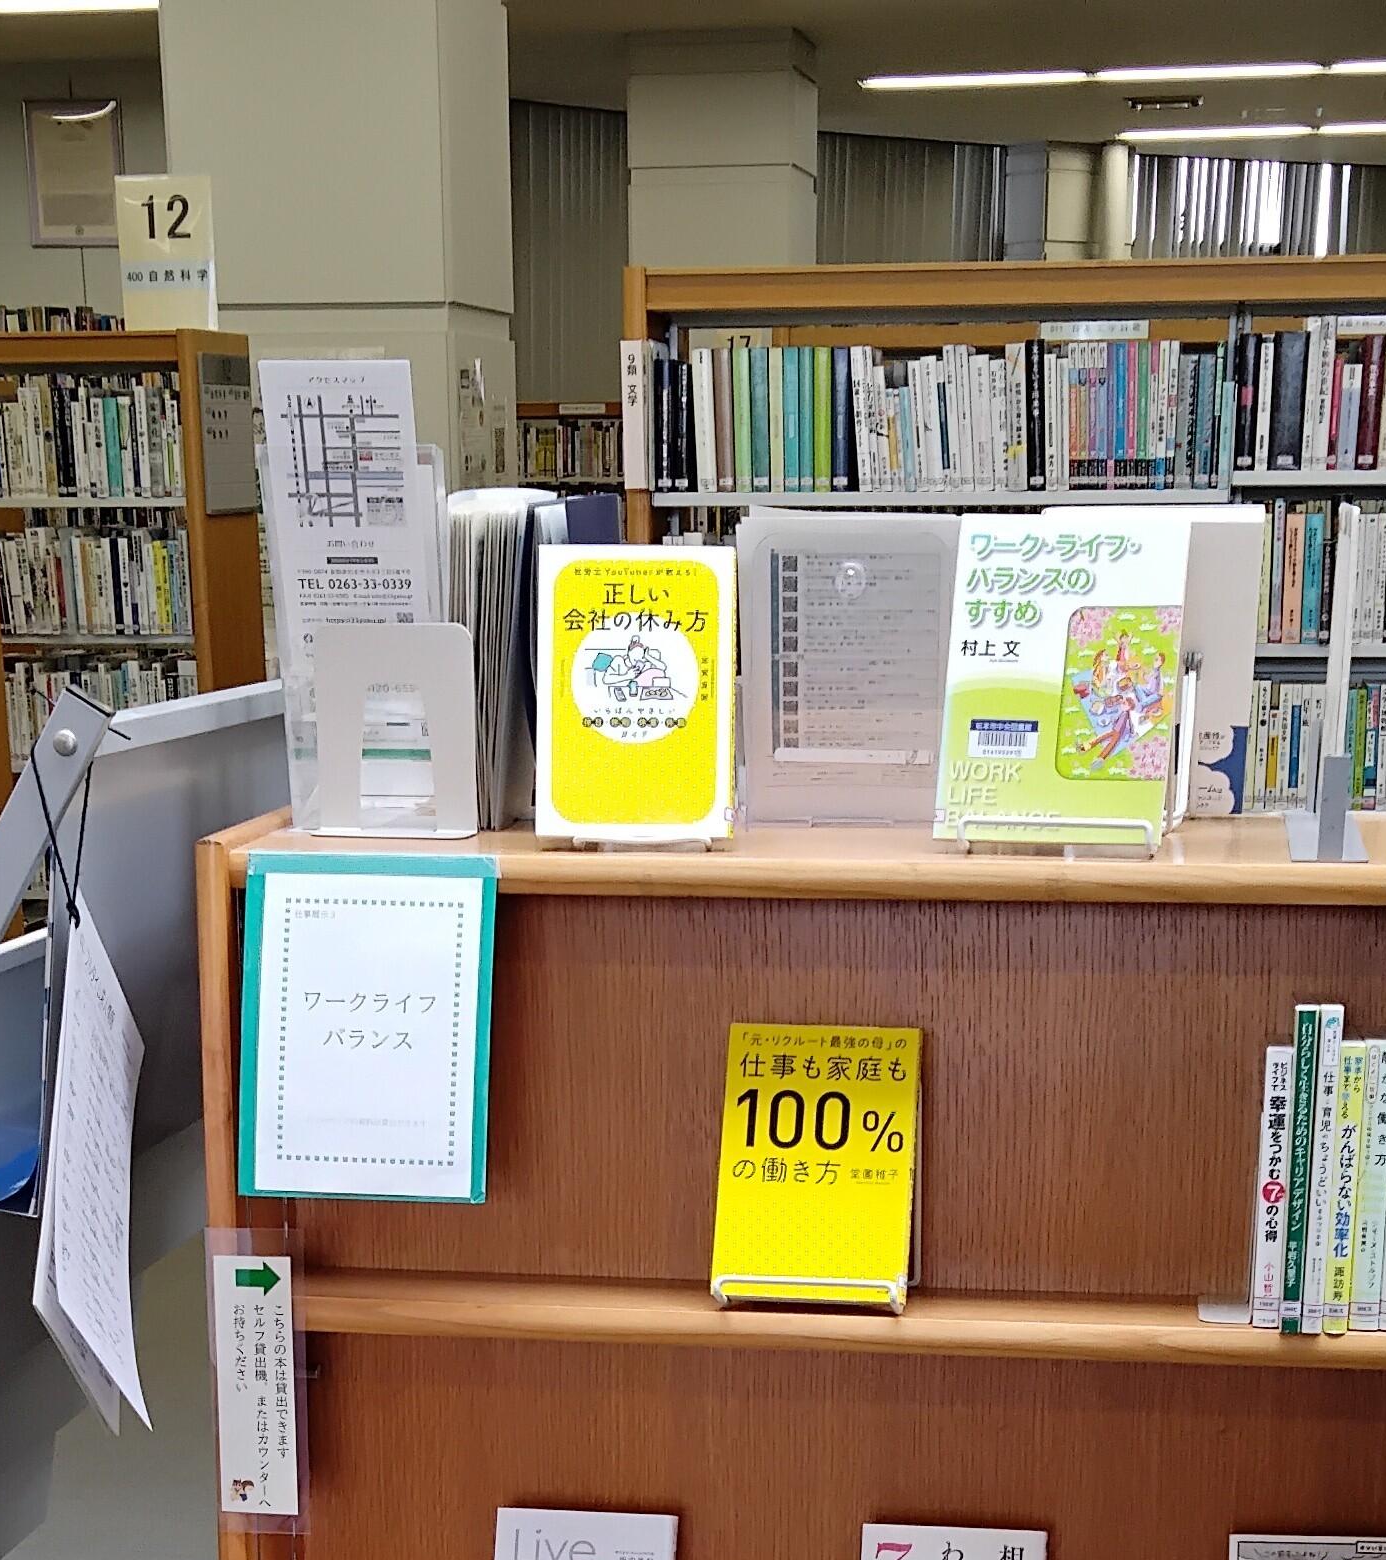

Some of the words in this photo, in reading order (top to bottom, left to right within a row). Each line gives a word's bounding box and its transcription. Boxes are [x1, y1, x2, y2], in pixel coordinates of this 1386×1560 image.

[140, 194, 192, 241] 12
[126, 269, 144, 284] 400
[147, 267, 209, 284] 自然科学
[625, 353, 638, 377] 9類
[625, 383, 638, 407] 文学
[326, 540, 375, 548] お問い合わせ
[970, 533, 1140, 560] ワーク・ライフ・
[297, 578, 325, 590] TEL
[328, 578, 412, 590] 0263-33-0339
[966, 566, 1095, 593] バランスの
[602, 582, 669, 605] 正しい
[562, 607, 710, 633] 会社の休み方
[965, 598, 1043, 627] すすめ
[960, 639, 996, 658] 村上
[1001, 640, 1021, 658] 文
[950, 761, 1024, 783] WORK
[949, 786, 999, 807] LIFE
[303, 991, 437, 1015] ワークライフ
[322, 1027, 414, 1051] バランス
[739, 1051, 907, 1082] 仕事も家庭も
[735, 1088, 905, 1153] 100%
[731, 1156, 841, 1186] の働き方
[1263, 1095, 1289, 1243] 幸運をつかむ7の心得
[1332, 1124, 1359, 1259] がんばらない効率化
[232, 1302, 249, 1393] お持ちください
[273, 1302, 290, 1460] こちらの本は貸出できます
[252, 1303, 272, 1508] セルフ貸出機、またはカウンターへ
